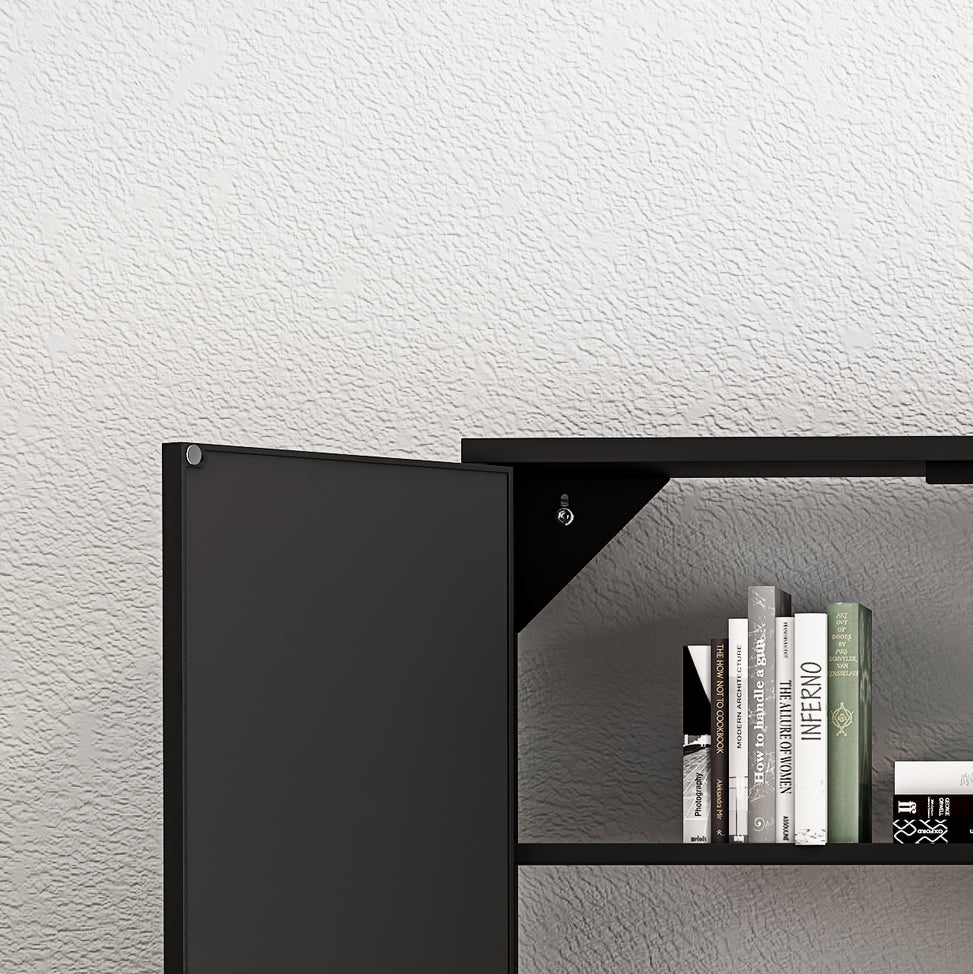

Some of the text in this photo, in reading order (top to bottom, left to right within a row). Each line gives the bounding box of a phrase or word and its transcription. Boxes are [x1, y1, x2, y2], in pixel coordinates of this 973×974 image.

[756, 669, 765, 678] a
[716, 644, 724, 754] THE HOW NOT TO COOKBOOK
[753, 680, 765, 730] handle
[801, 661, 822, 741] INFERNO
[754, 732, 765, 747] to
[780, 680, 792, 794] THE ALLURE OF WOMEN
[754, 750, 765, 784] How
[694, 771, 704, 817] Photography
